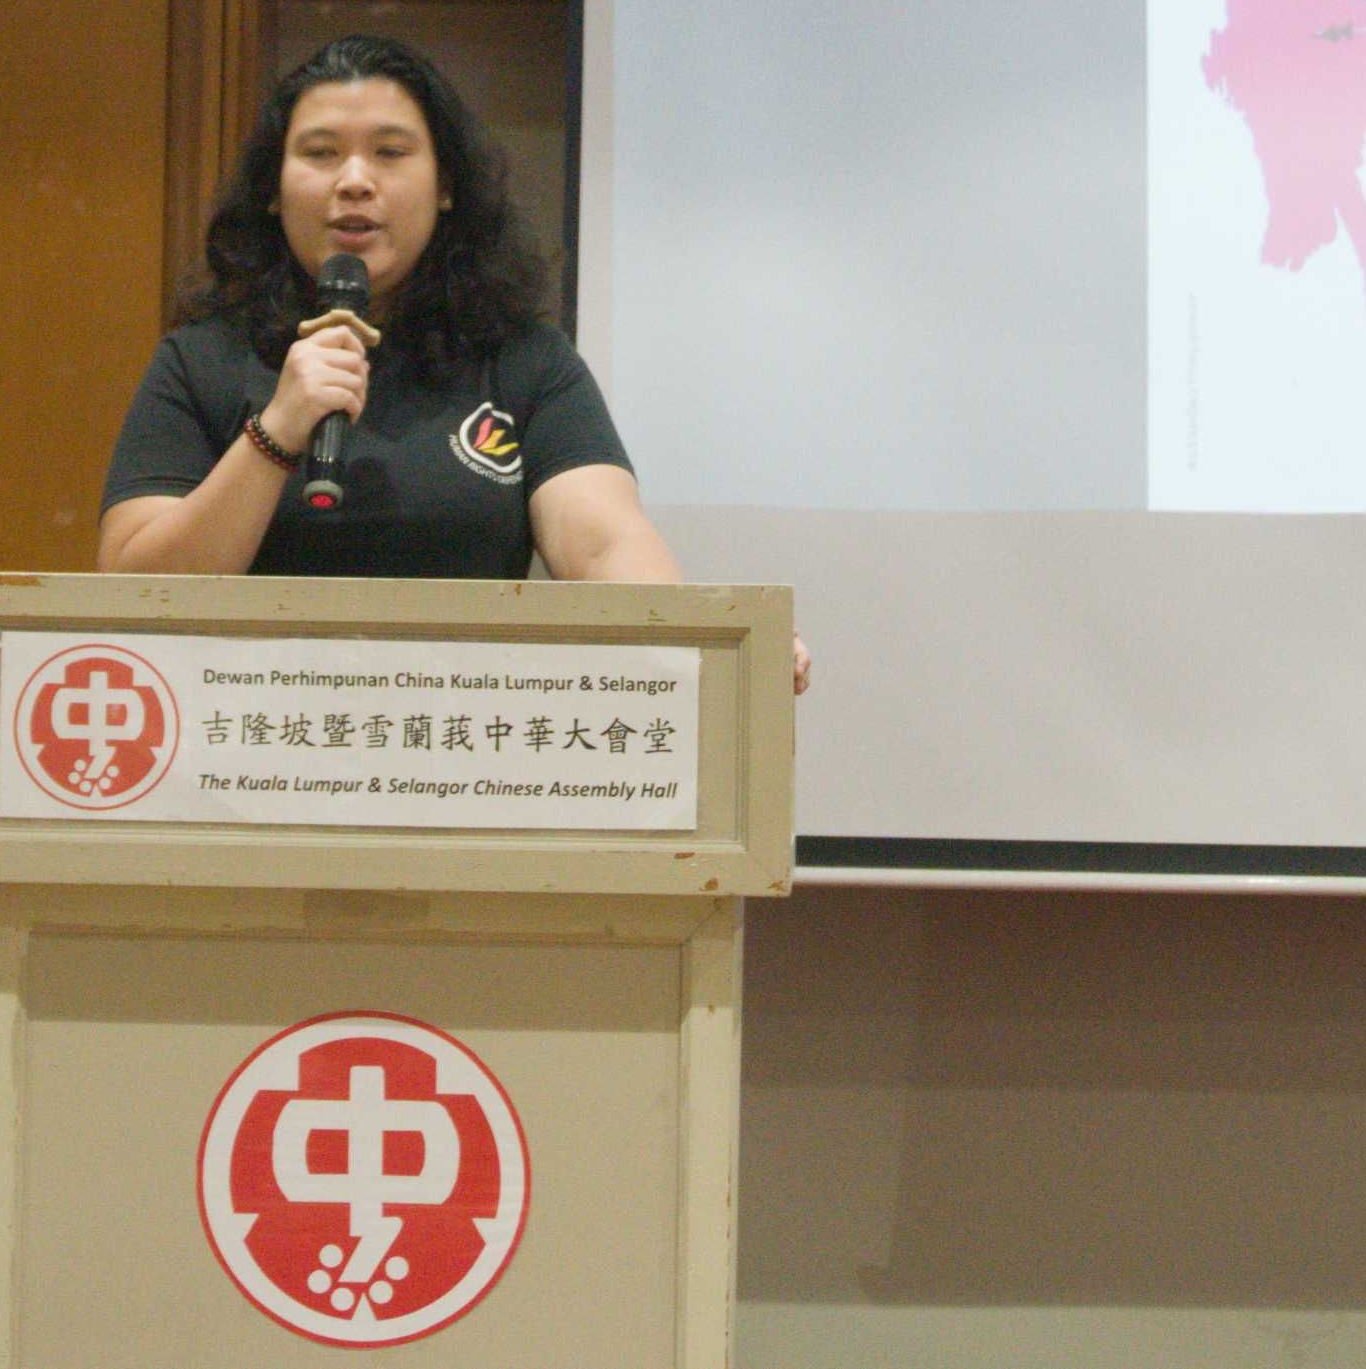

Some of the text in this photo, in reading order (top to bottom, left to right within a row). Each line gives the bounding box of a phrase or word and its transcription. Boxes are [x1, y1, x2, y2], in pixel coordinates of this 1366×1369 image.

[202, 668, 678, 696] Dewan Perhimpunan China Kuala Lumpur & Selangor
[202, 710, 677, 754] 吉隆坡暨雪蘭莪中華大會堂
[199, 773, 678, 802] The Kuala Lumpur & Selangor Chinese Assembly Hall
